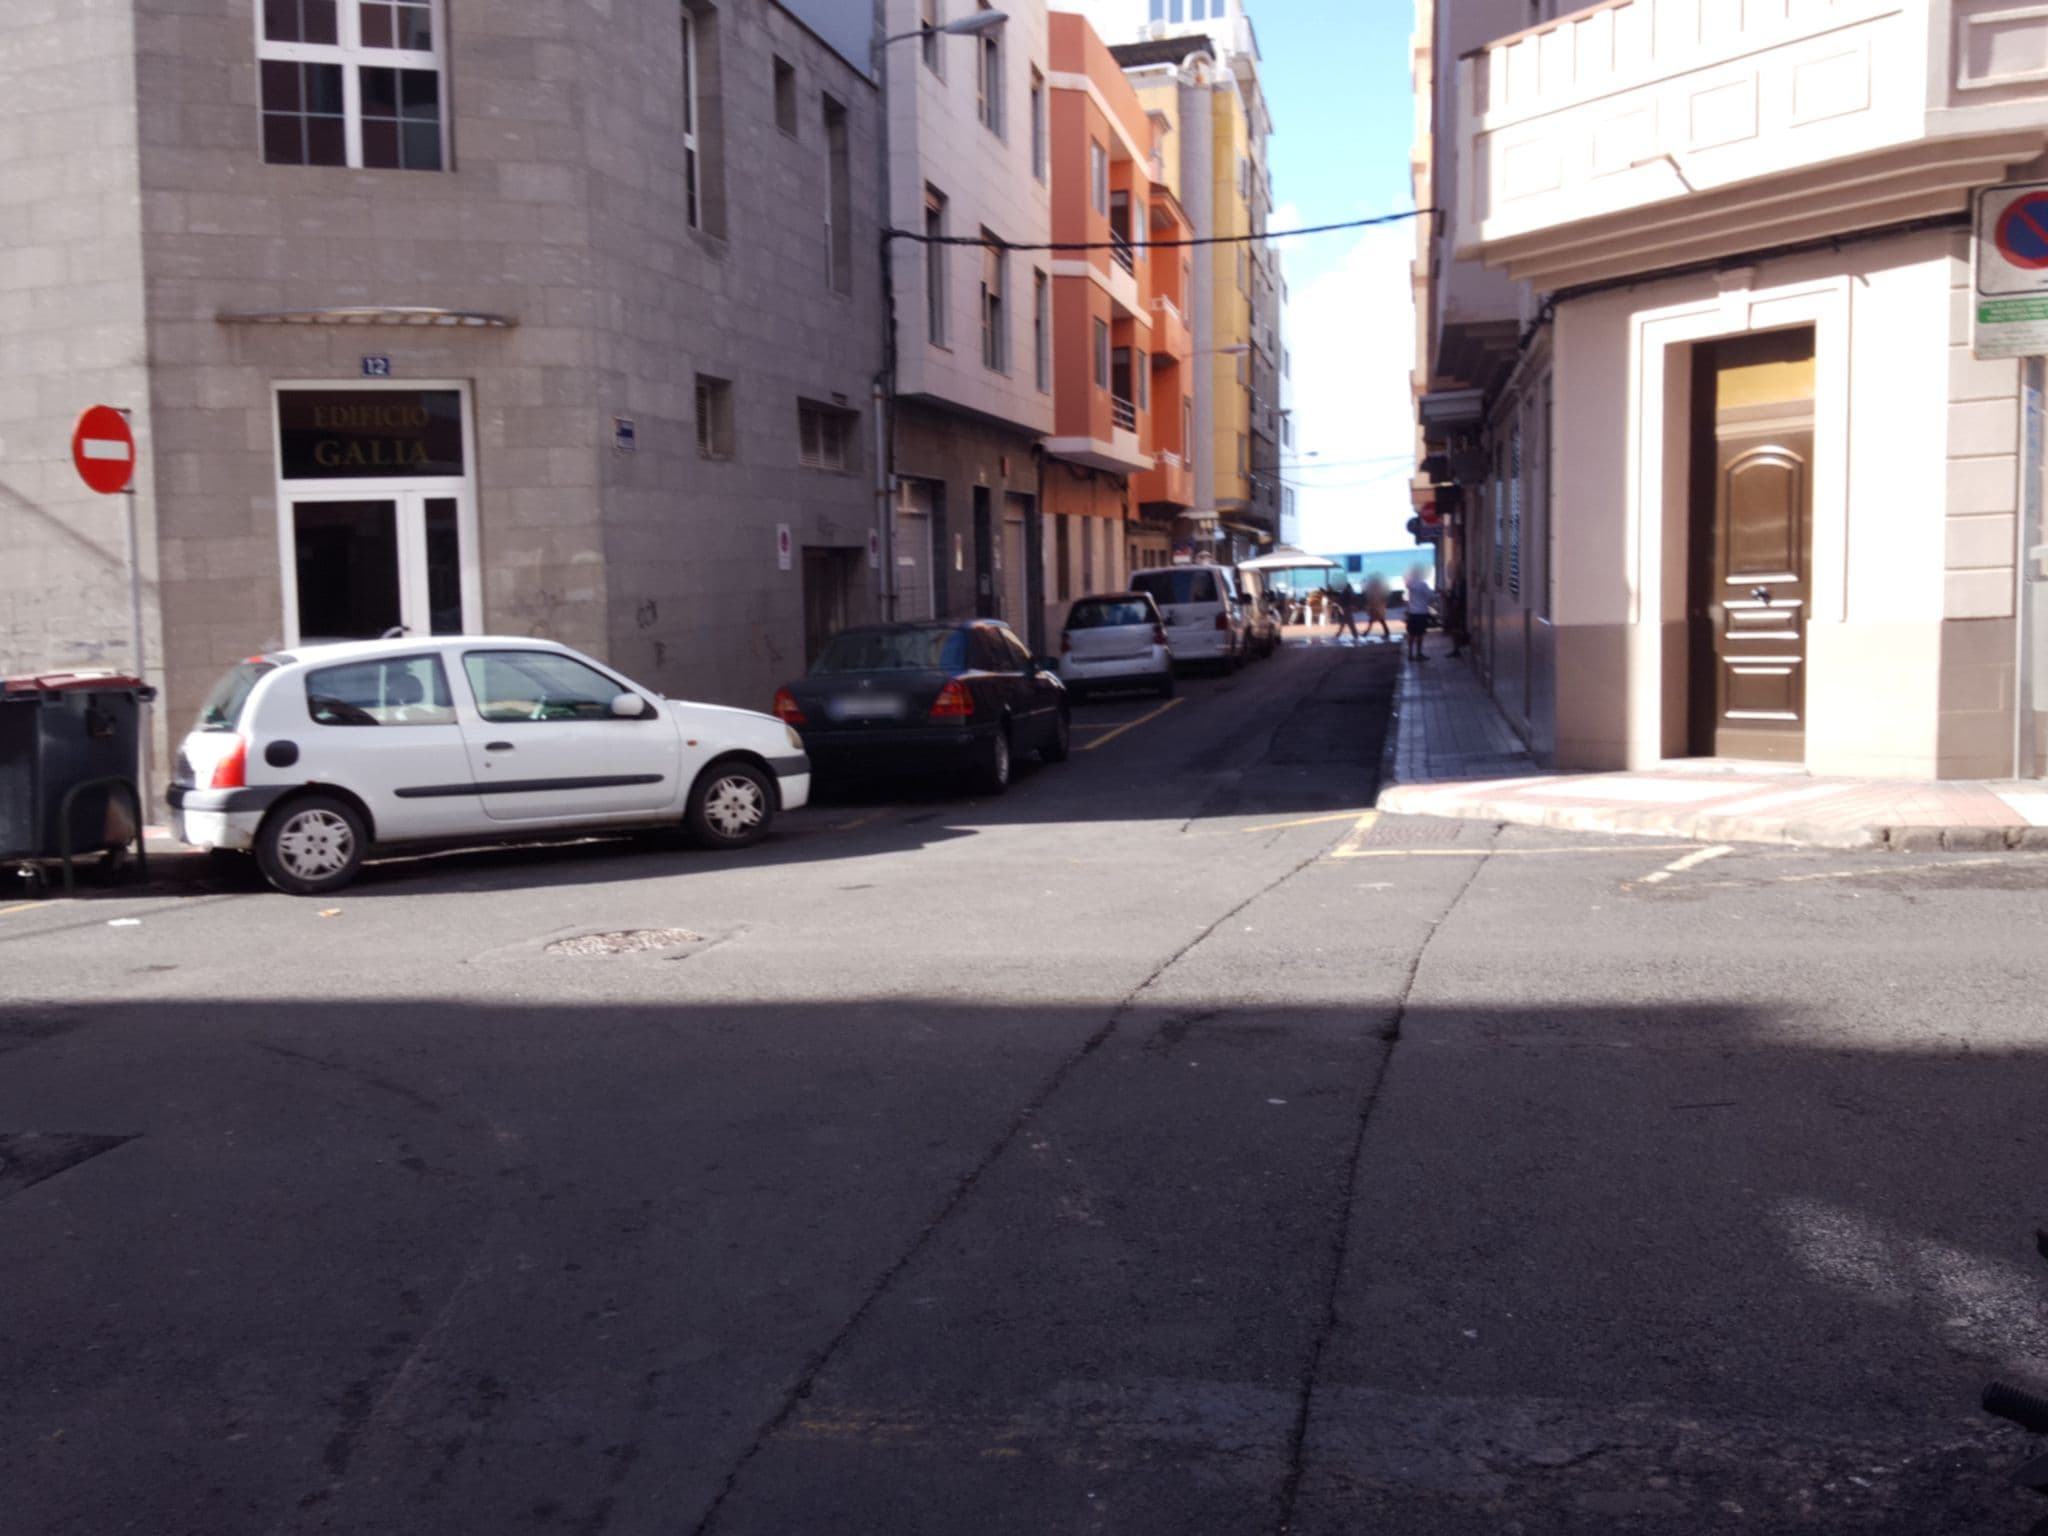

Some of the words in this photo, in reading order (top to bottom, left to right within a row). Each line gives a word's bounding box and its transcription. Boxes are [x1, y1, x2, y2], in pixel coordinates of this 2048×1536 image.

[366, 358, 386, 375] 12
[314, 405, 429, 428] EDIFICIO
[314, 440, 431, 466] GALIA
